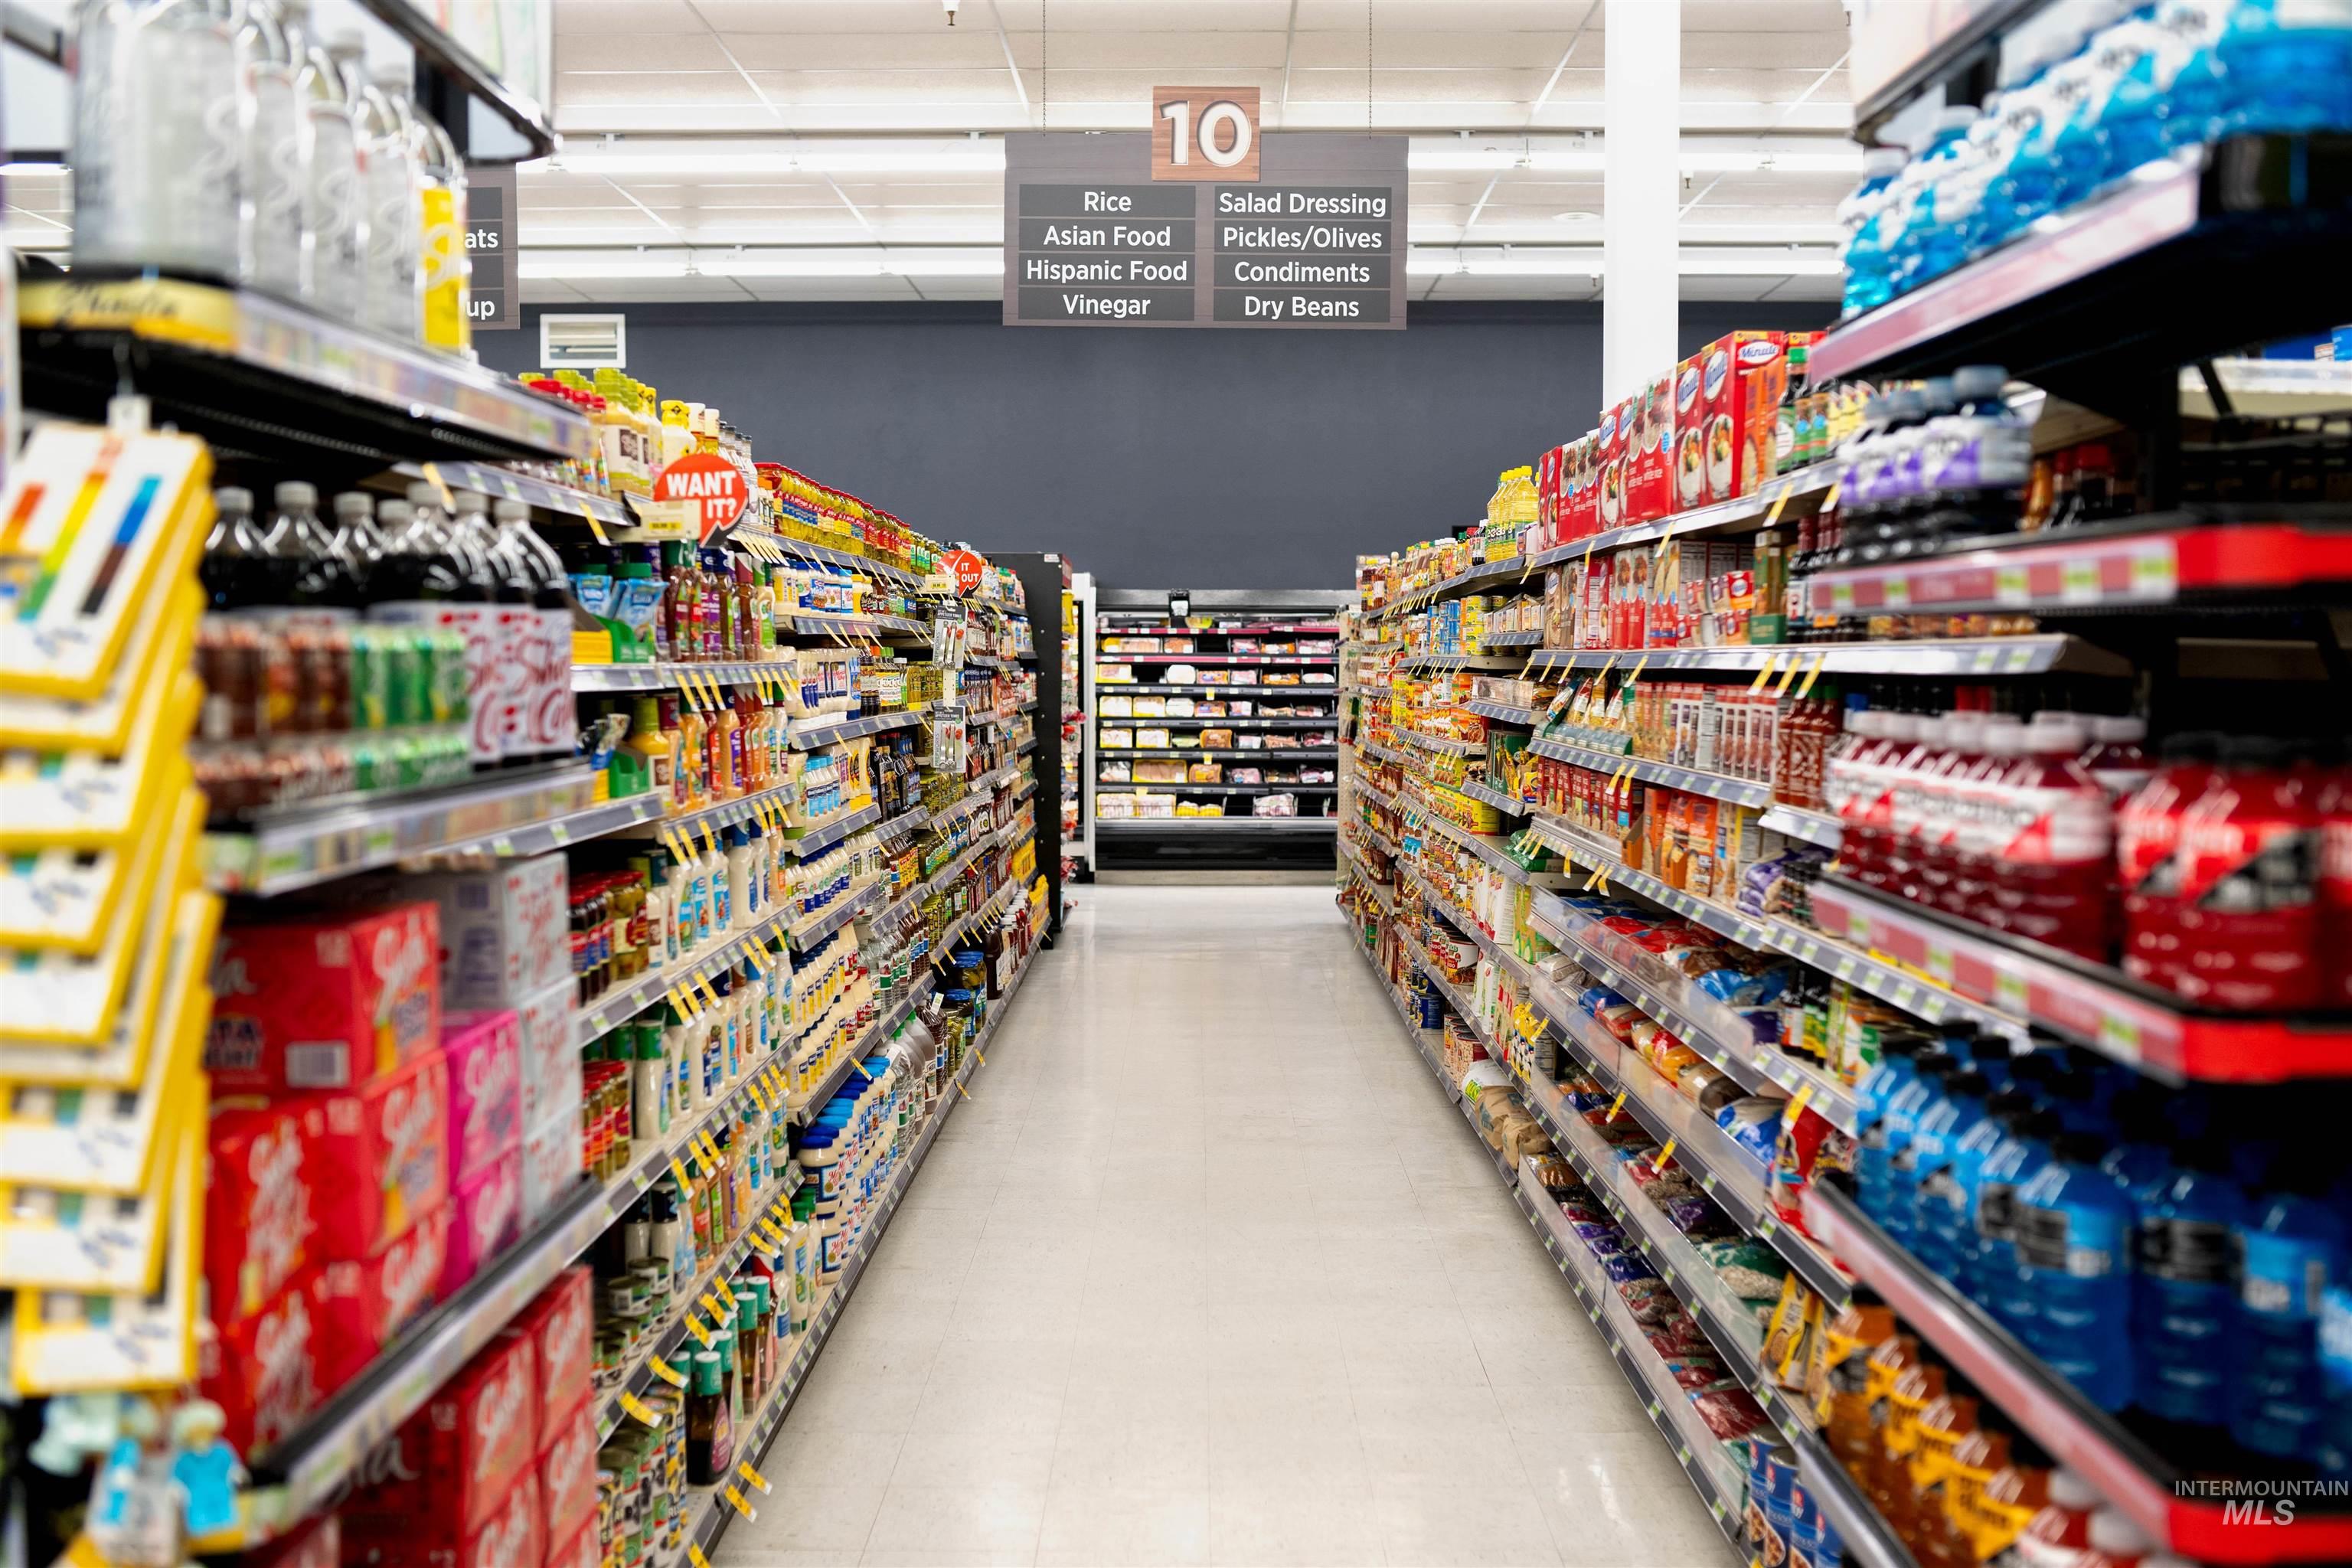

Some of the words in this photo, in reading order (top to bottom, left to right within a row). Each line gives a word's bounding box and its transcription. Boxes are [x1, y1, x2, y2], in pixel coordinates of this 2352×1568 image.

[1158, 100, 1253, 167] 10
[1084, 191, 1132, 212] Rice
[1219, 192, 1281, 214] Salad
[1289, 193, 1387, 217] Dressing
[1043, 225, 1106, 246] Asian
[1113, 226, 1171, 247] Food
[1223, 225, 1382, 251] Pickles/Olives
[1027, 259, 1122, 284] Hispanic
[1130, 260, 1187, 281] Food
[1234, 261, 1370, 283] Condiments
[1062, 293, 1151, 318] Vinegar
[1244, 296, 1284, 320] Dry
[1292, 296, 1360, 317] Beans
[666, 469, 737, 497] WANT
[706, 498, 737, 519] IT?
[961, 562, 970, 571] IT
[961, 573, 979, 582] OUT
